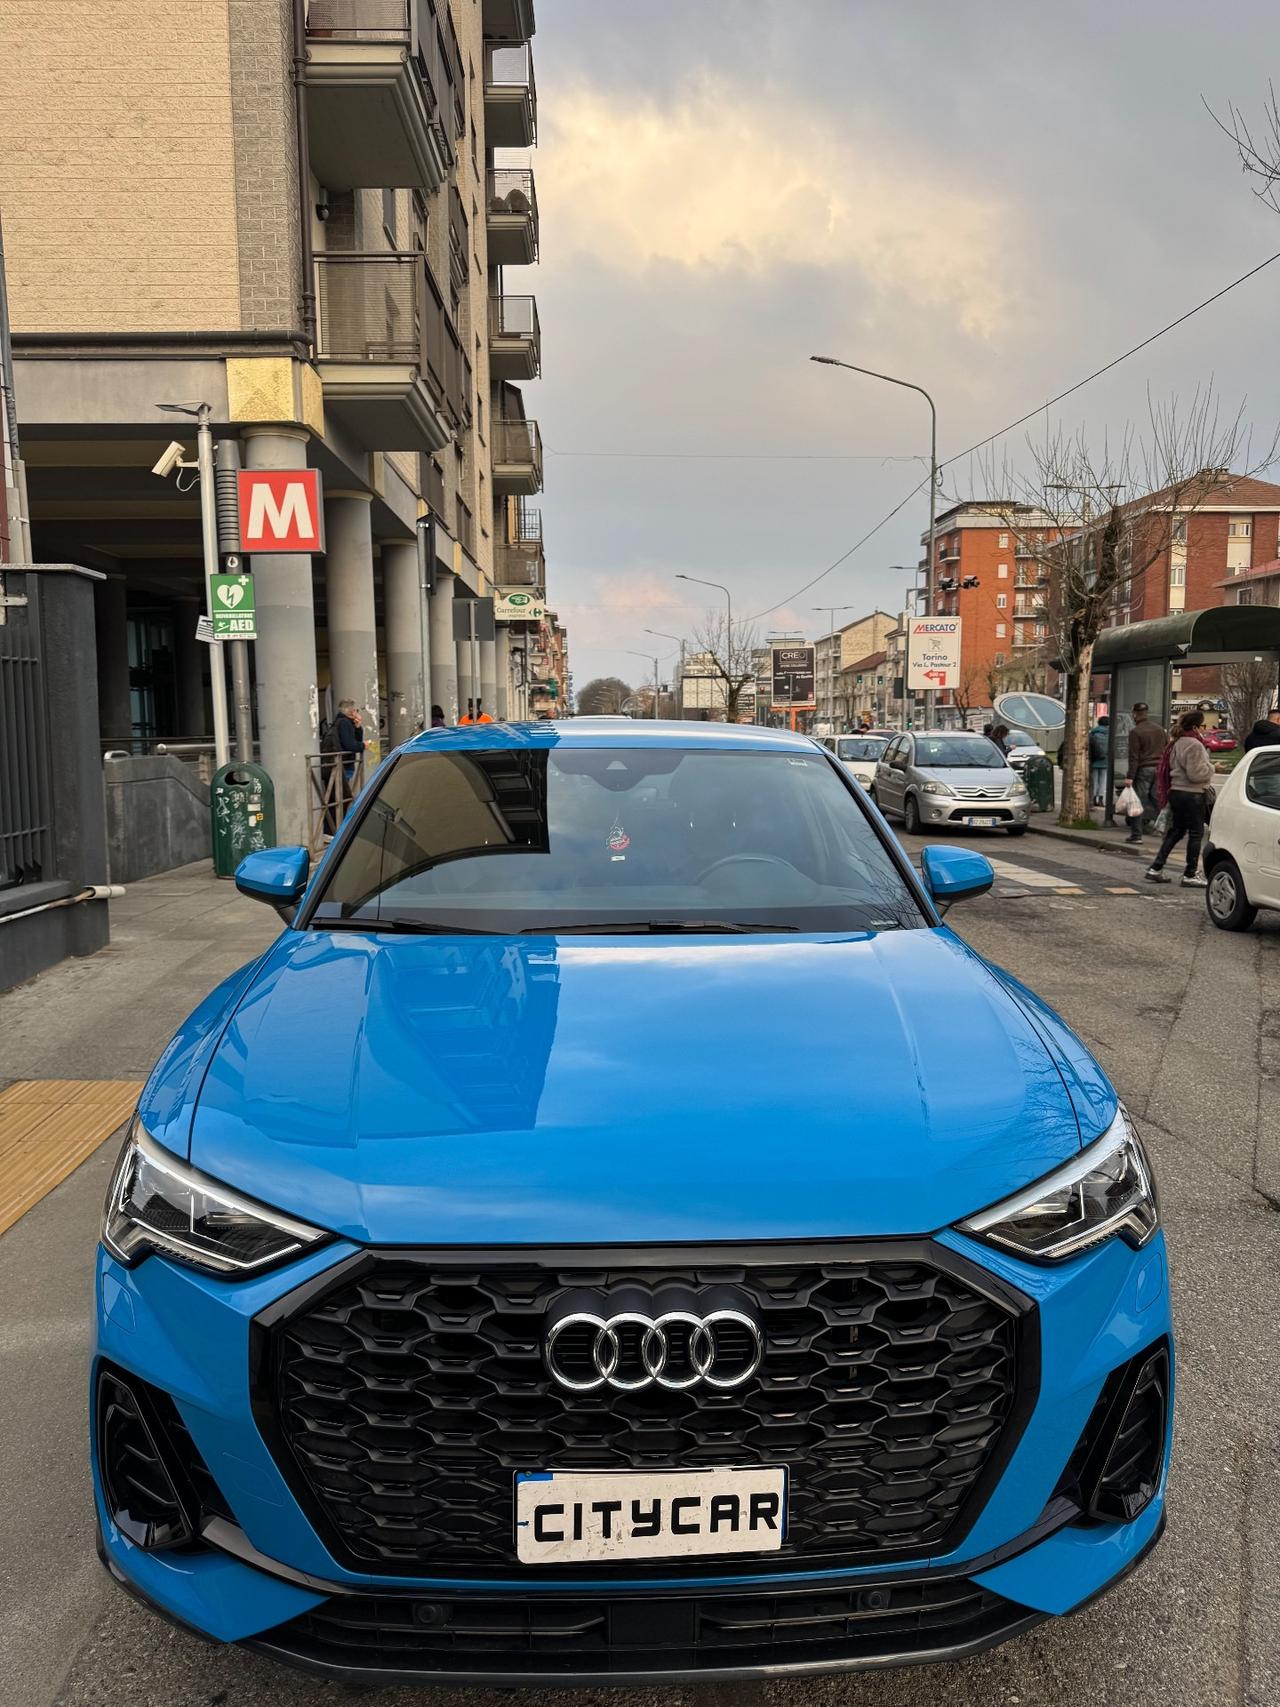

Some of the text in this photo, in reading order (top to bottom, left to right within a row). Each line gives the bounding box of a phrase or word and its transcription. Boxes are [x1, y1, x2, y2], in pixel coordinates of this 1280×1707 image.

[247, 482, 314, 538] M
[229, 620, 254, 631] AED
[534, 1492, 780, 1542] CITYCAR
